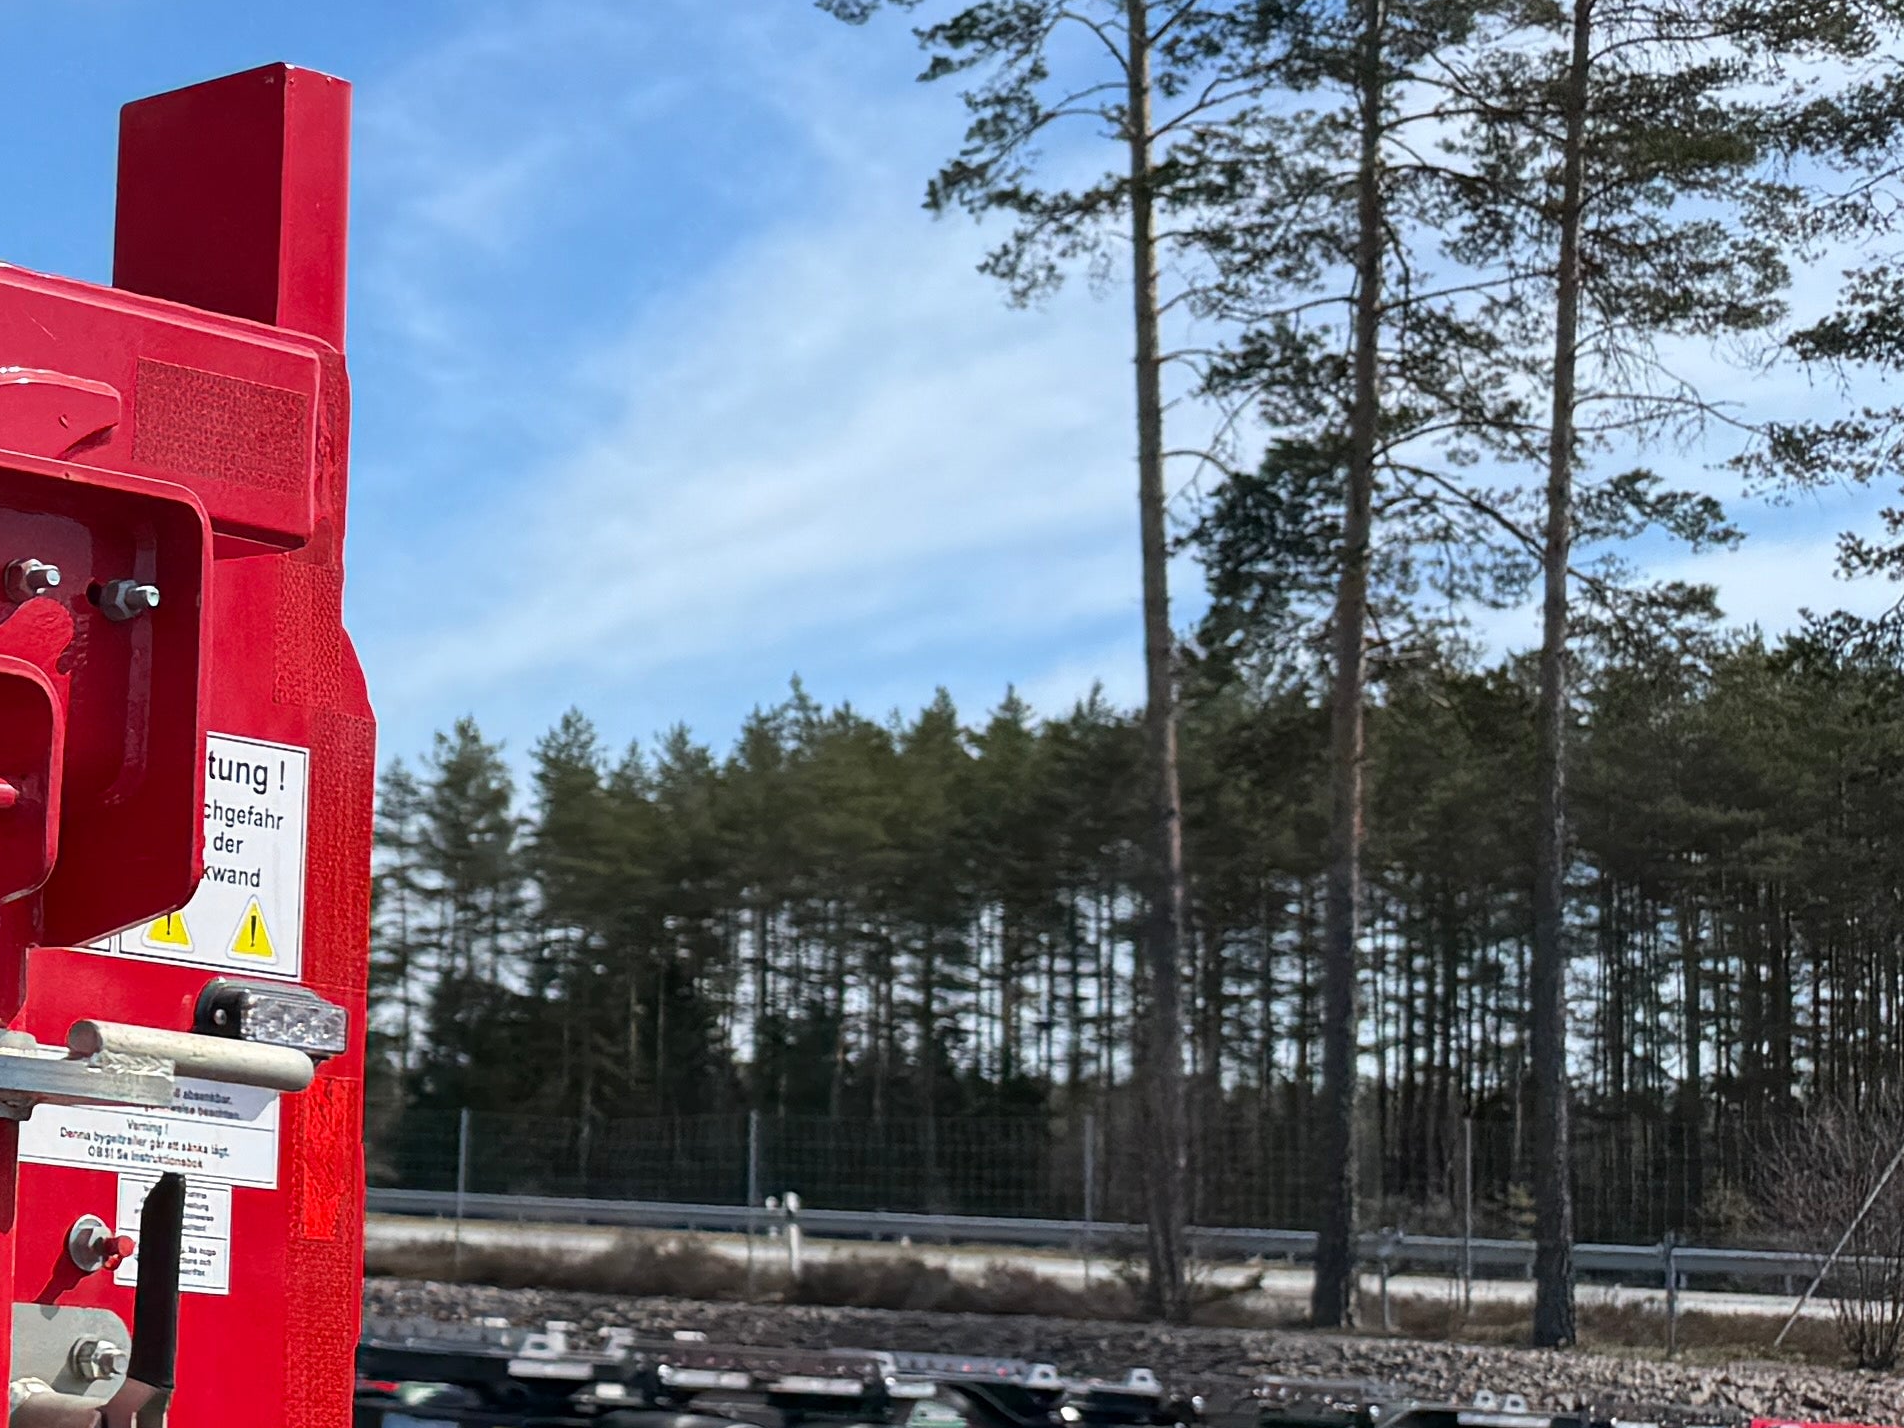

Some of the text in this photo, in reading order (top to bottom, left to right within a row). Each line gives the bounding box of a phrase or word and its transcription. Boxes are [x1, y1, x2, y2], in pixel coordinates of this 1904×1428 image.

[208, 750, 268, 795] tung
[203, 798, 284, 831] chgefahr
[212, 830, 245, 855] der
[202, 865, 262, 889] kwand
